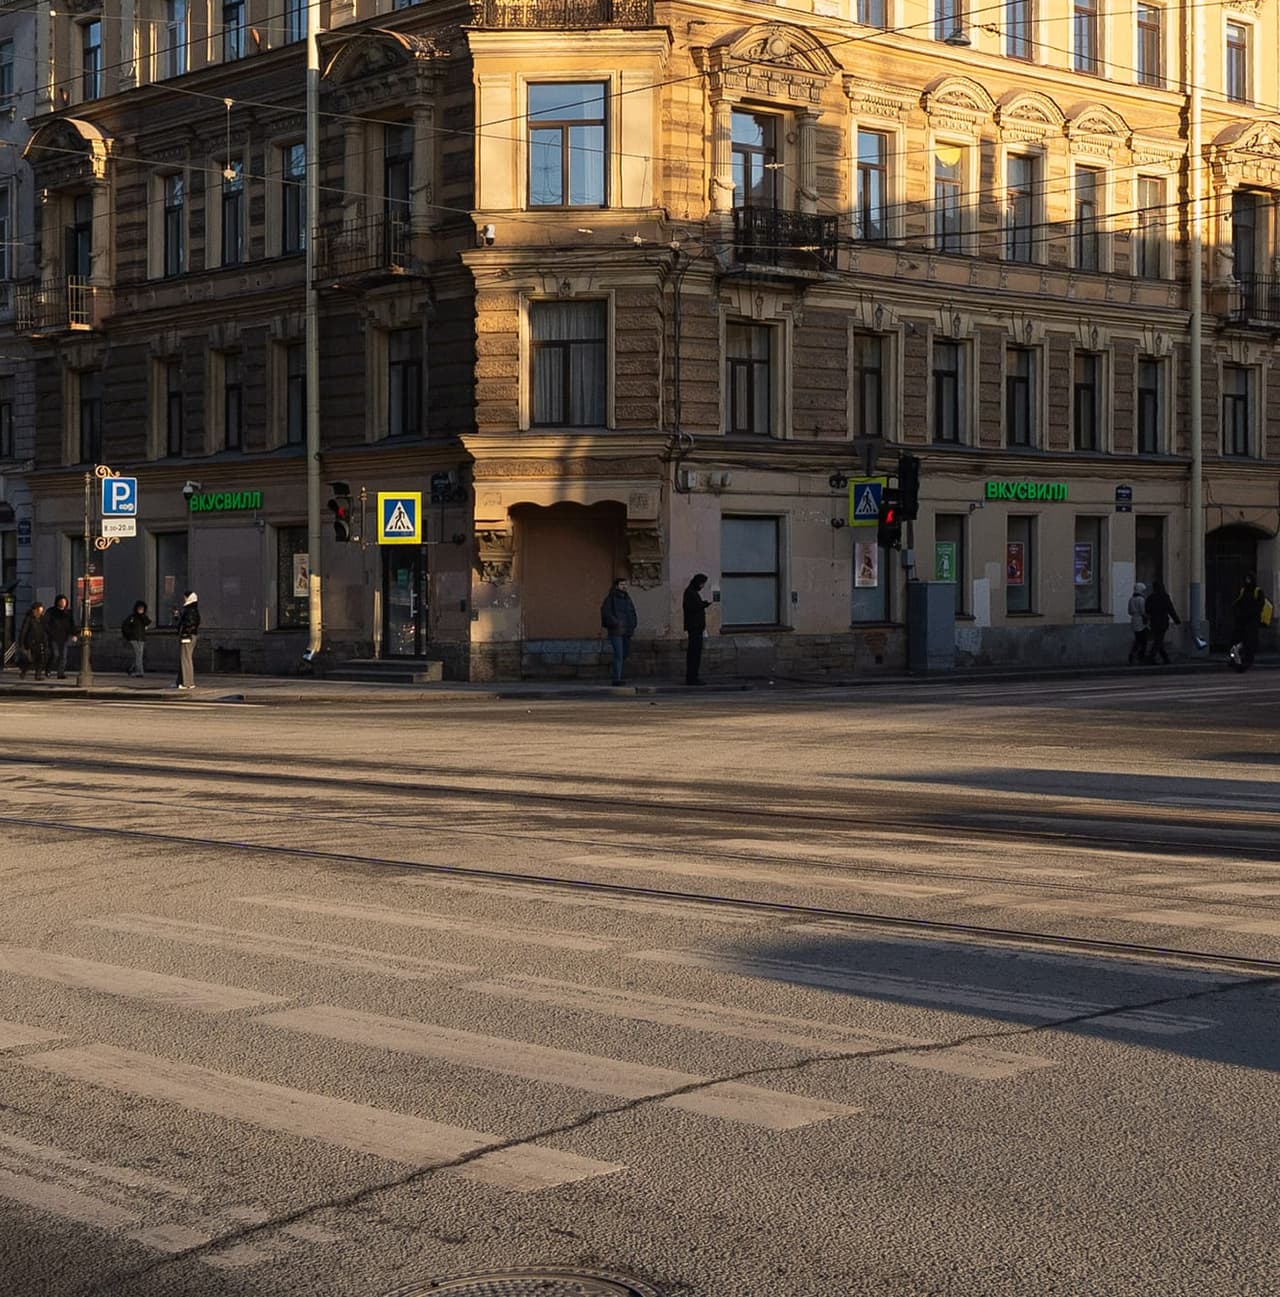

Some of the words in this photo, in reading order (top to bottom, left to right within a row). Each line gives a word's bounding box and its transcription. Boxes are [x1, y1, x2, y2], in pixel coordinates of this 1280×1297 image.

[112, 481, 130, 510] P
[189, 491, 261, 512] ВКУСВИЛЛ
[985, 481, 1069, 501] ВКУСВИЛЛ
